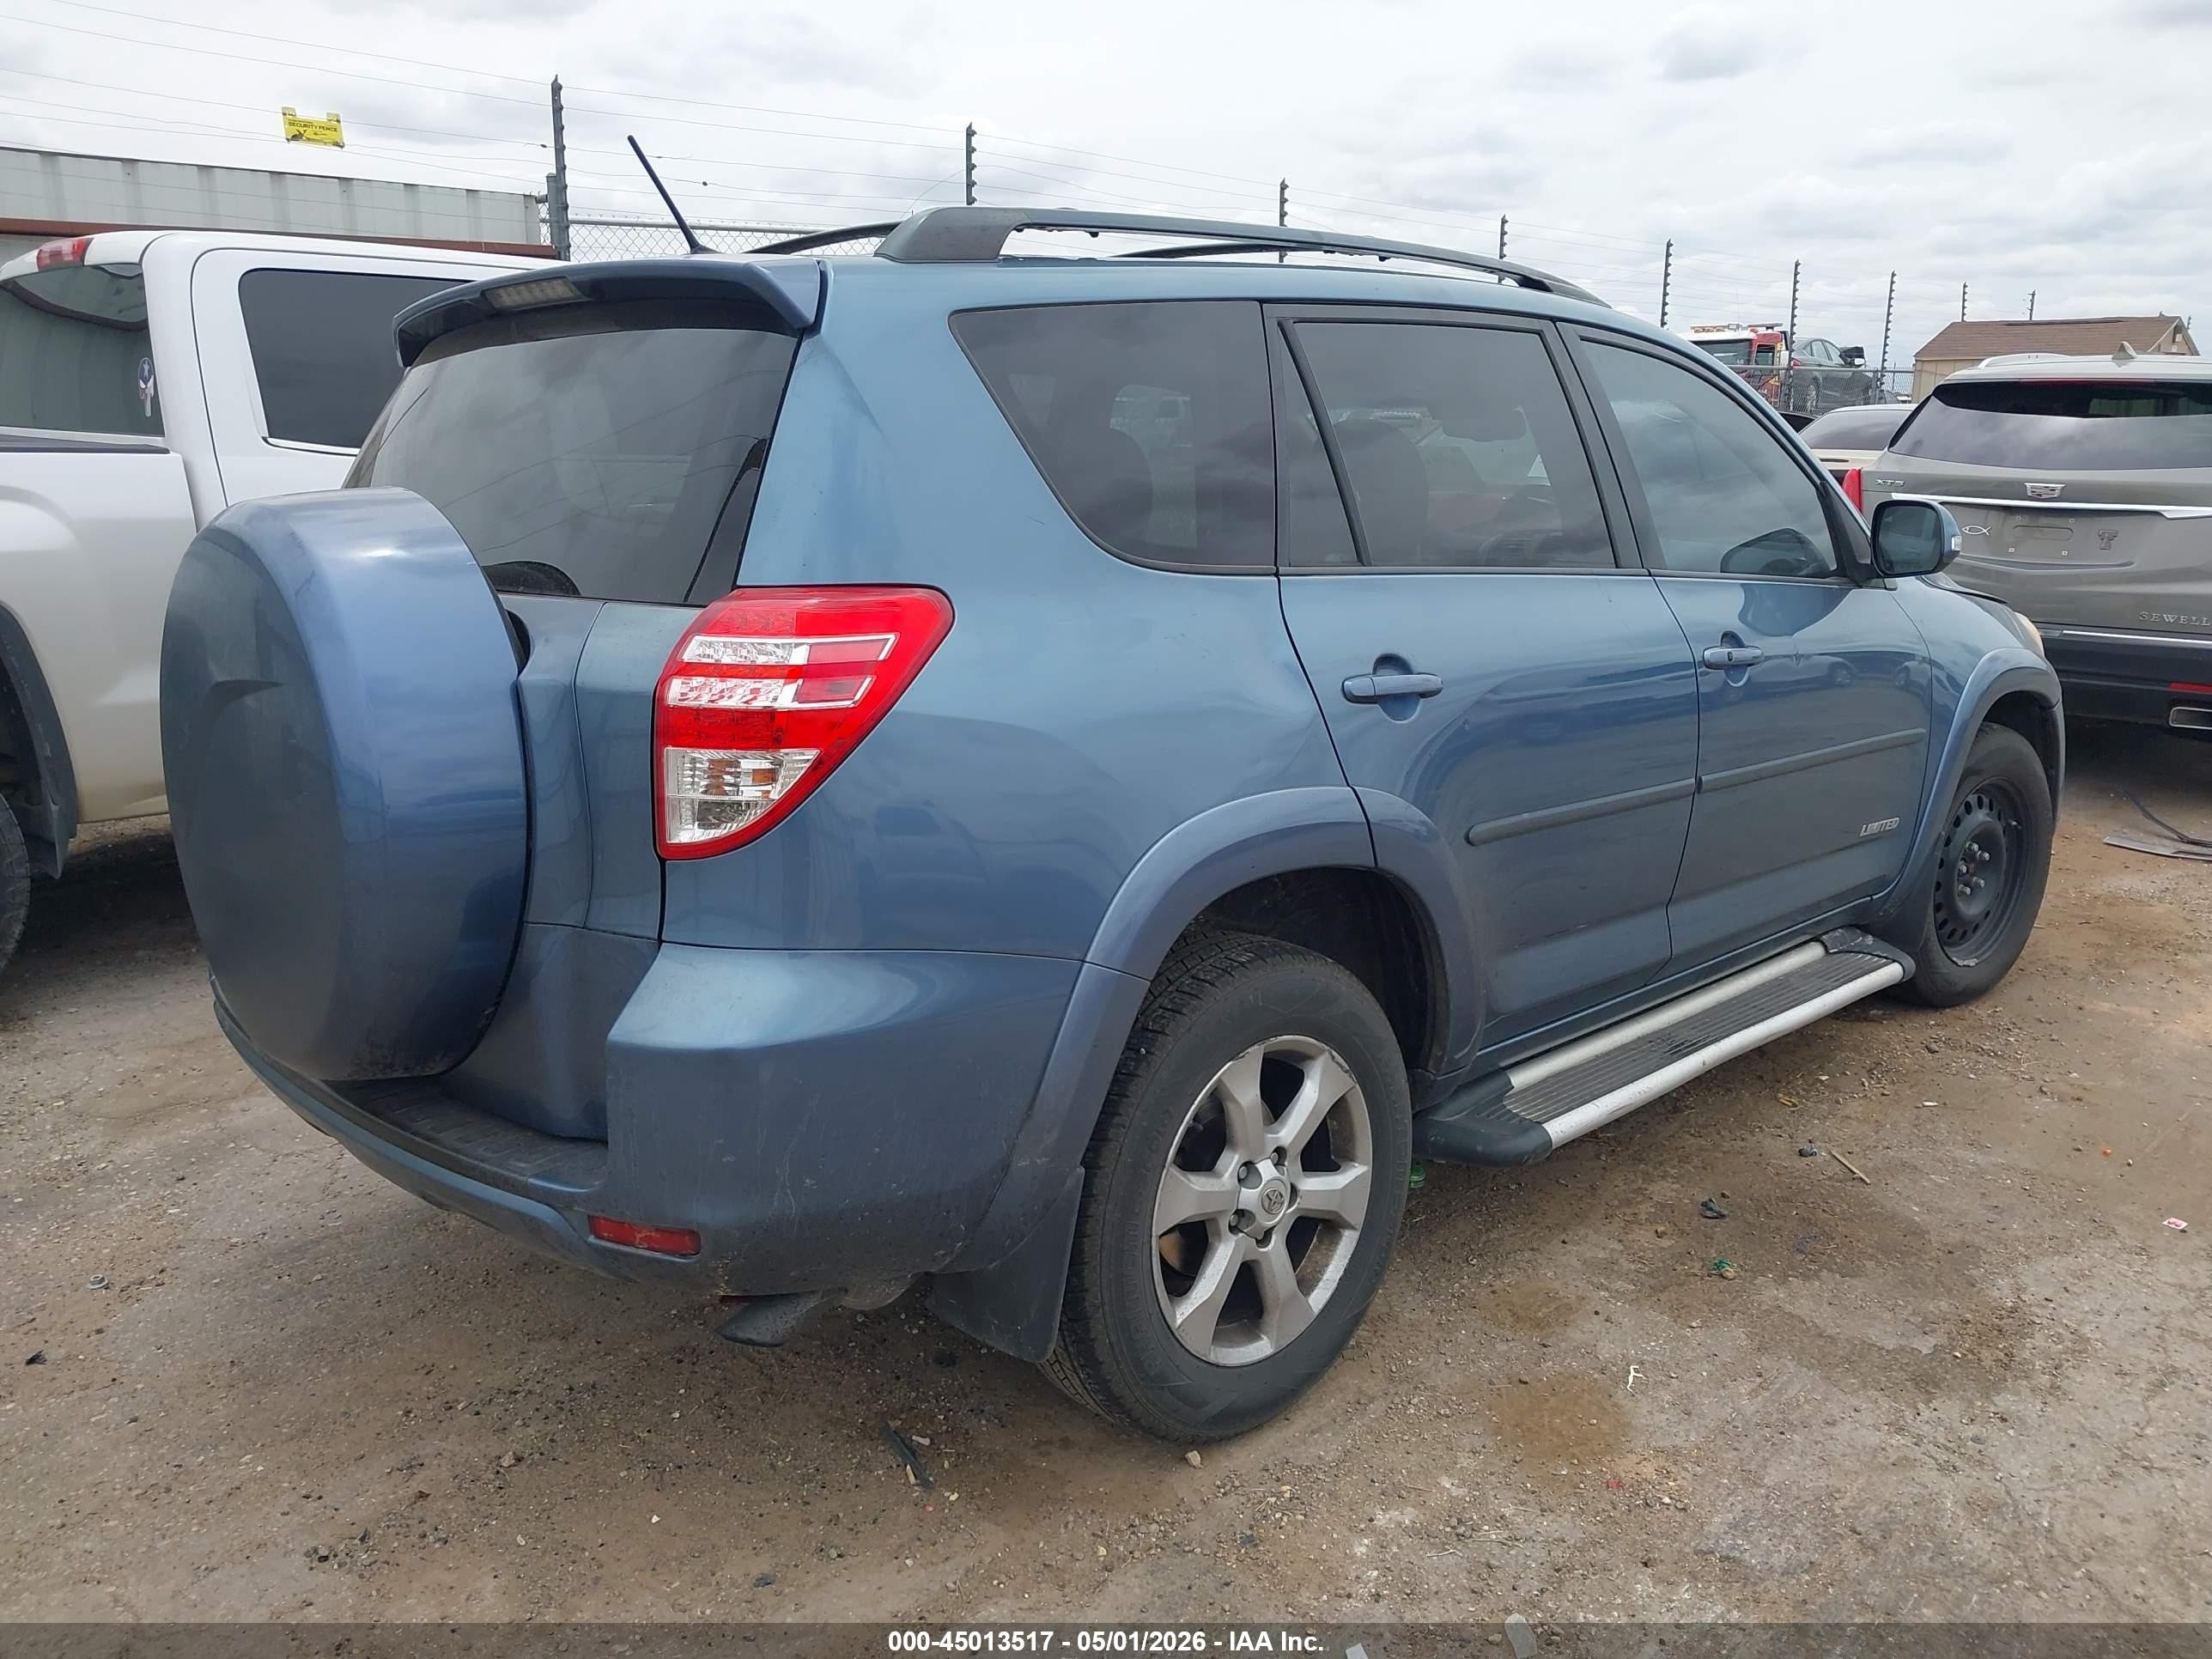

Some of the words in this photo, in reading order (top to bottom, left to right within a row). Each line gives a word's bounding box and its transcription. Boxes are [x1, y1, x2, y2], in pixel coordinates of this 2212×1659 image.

[288, 122, 318, 131] SECURITY
[2138, 611, 2211, 626] SEWELL
[1859, 817, 1900, 837] LIMITED
